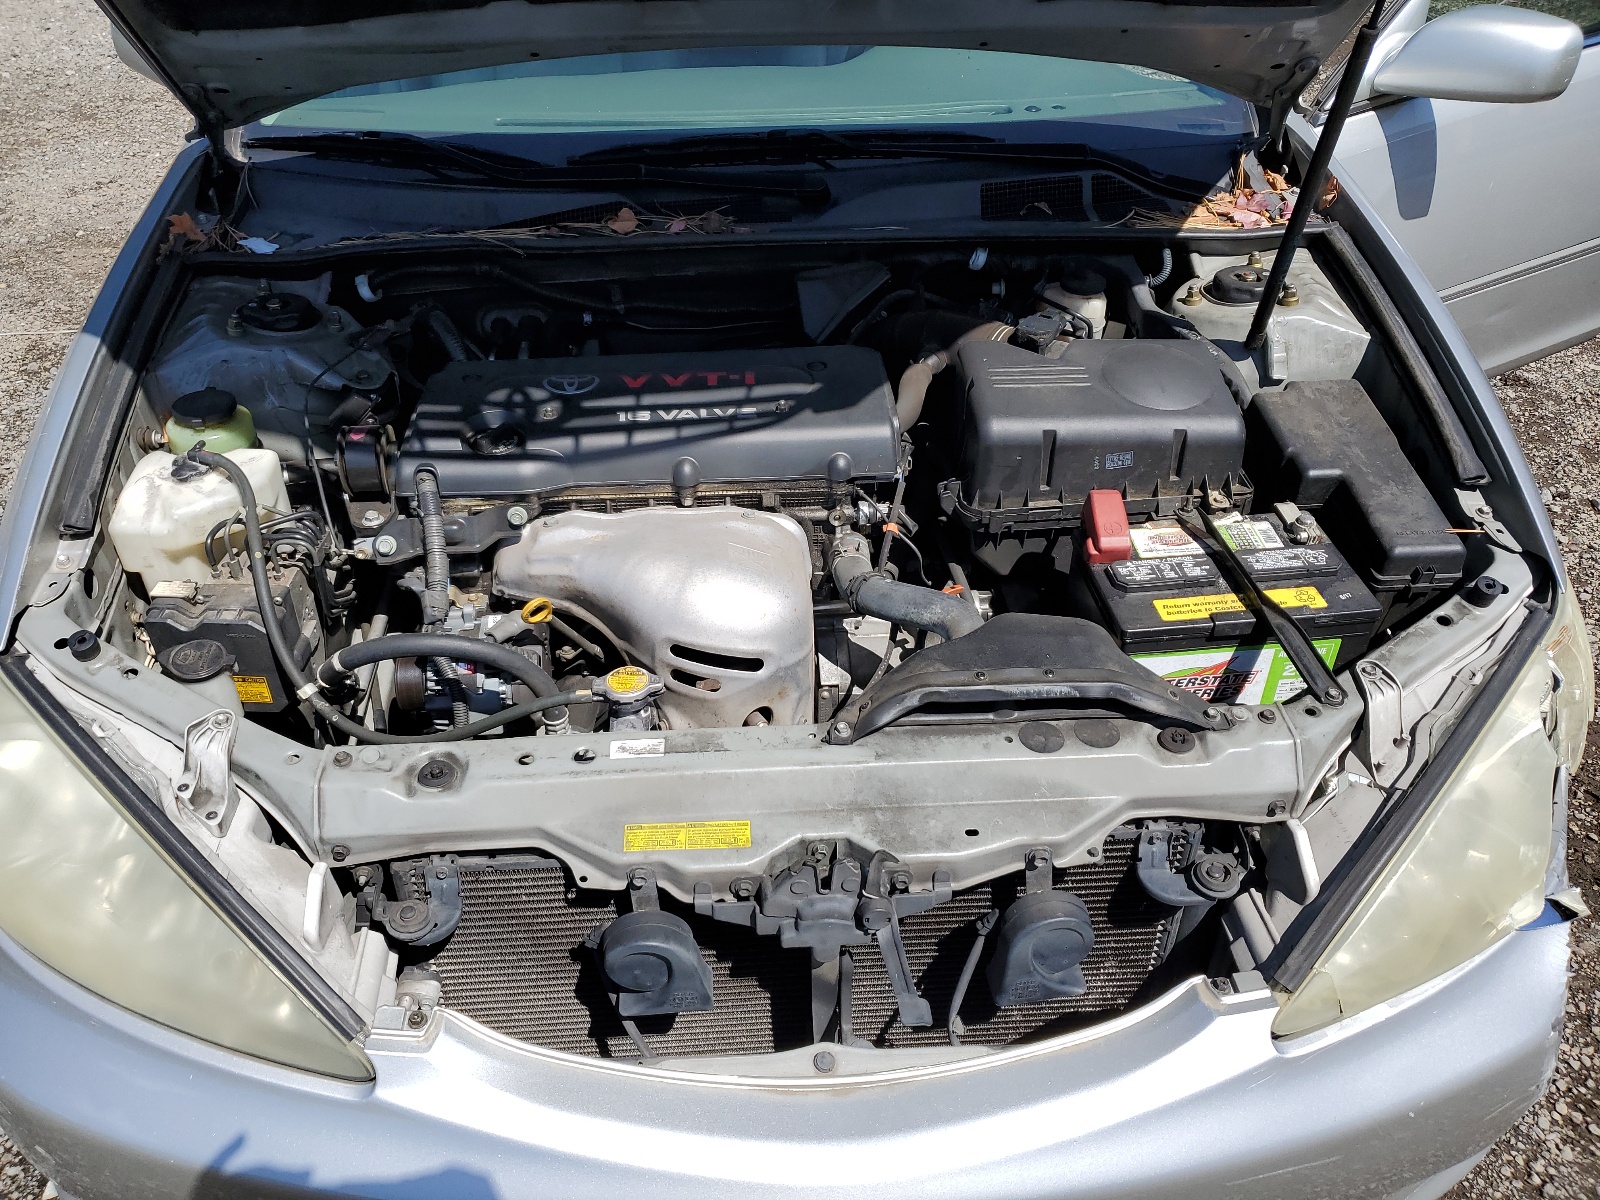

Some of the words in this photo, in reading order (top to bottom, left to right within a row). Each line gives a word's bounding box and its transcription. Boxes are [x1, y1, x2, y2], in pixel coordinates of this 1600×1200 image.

[616, 410, 651, 421] 16
[656, 407, 757, 420] VALVE
[1192, 599, 1228, 607] warranty
[1166, 608, 1203, 616] batteries
[1165, 671, 1255, 688] TERSTATE
